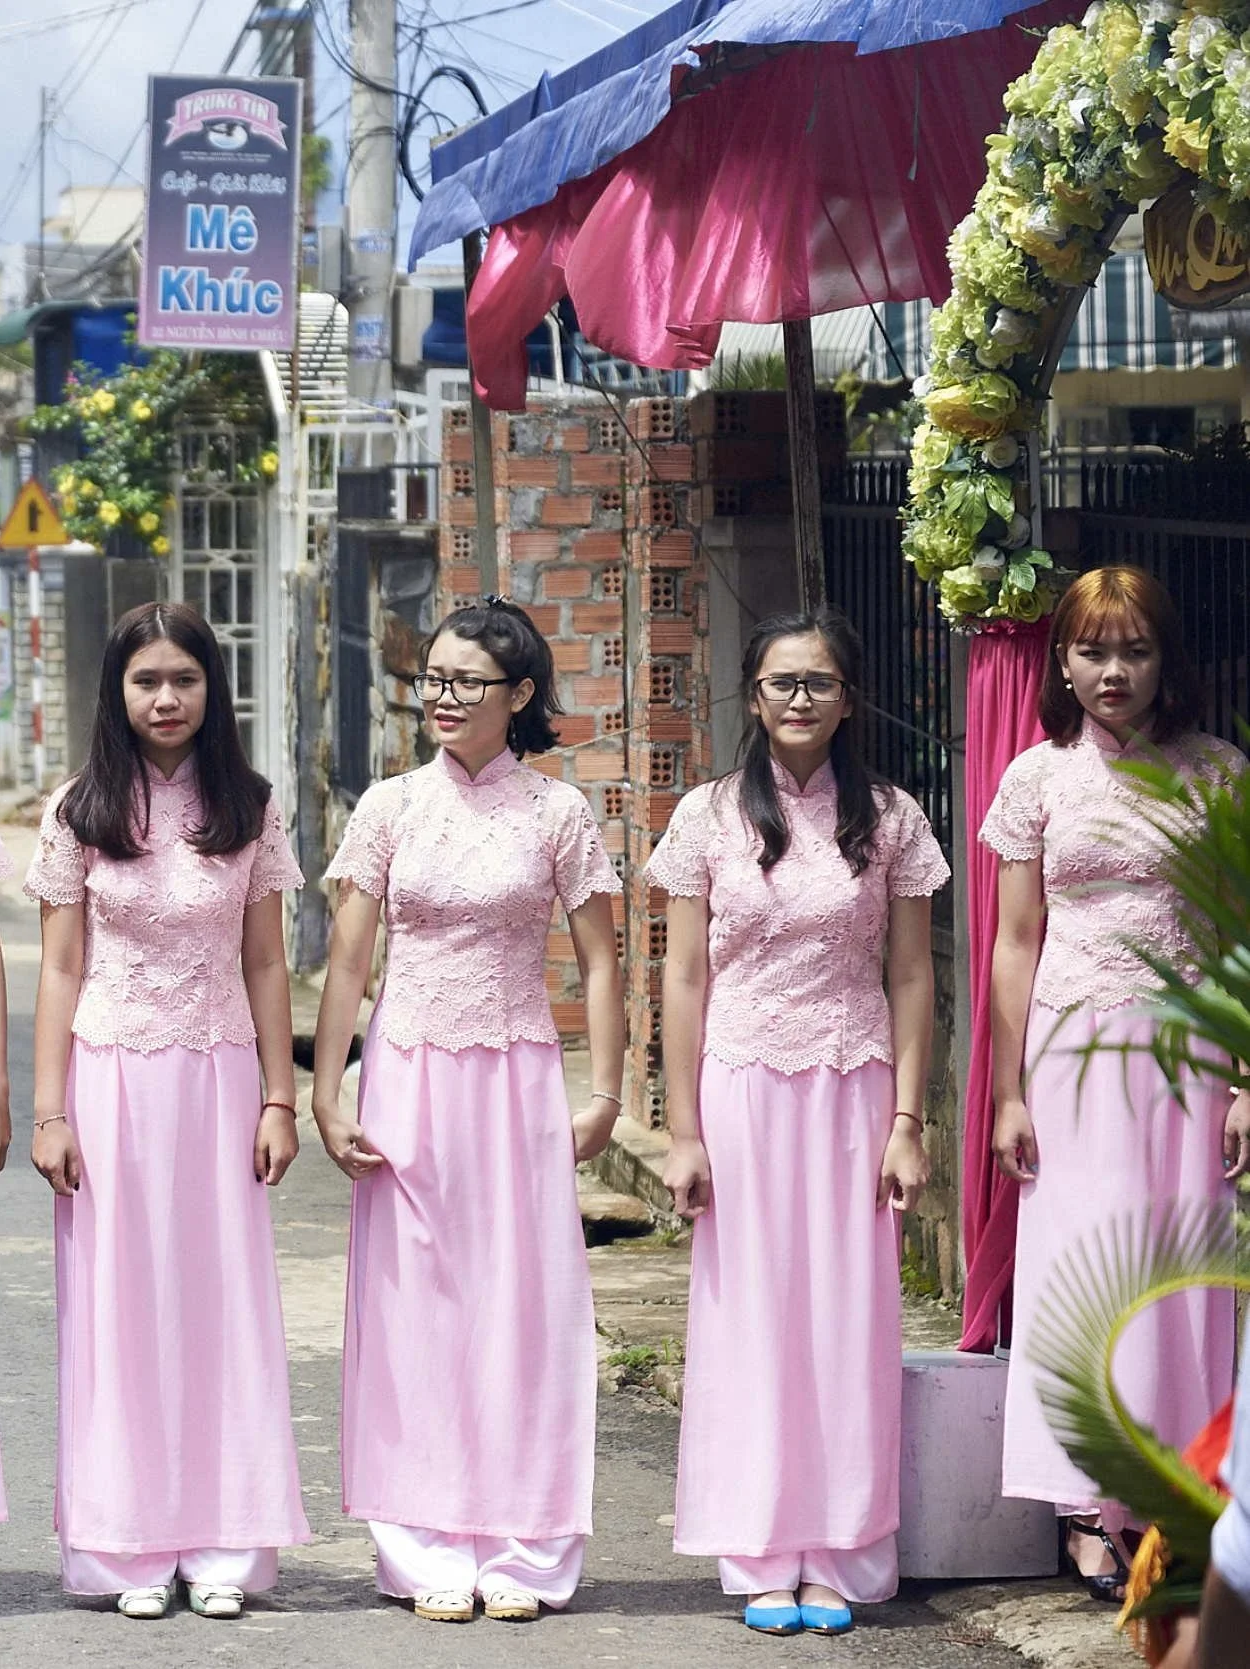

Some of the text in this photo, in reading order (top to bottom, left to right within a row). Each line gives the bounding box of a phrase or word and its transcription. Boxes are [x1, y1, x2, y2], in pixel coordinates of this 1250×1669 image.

[184, 93, 237, 120] TRUNG
[187, 203, 258, 254] Mê
[158, 266, 283, 316] Khúc
